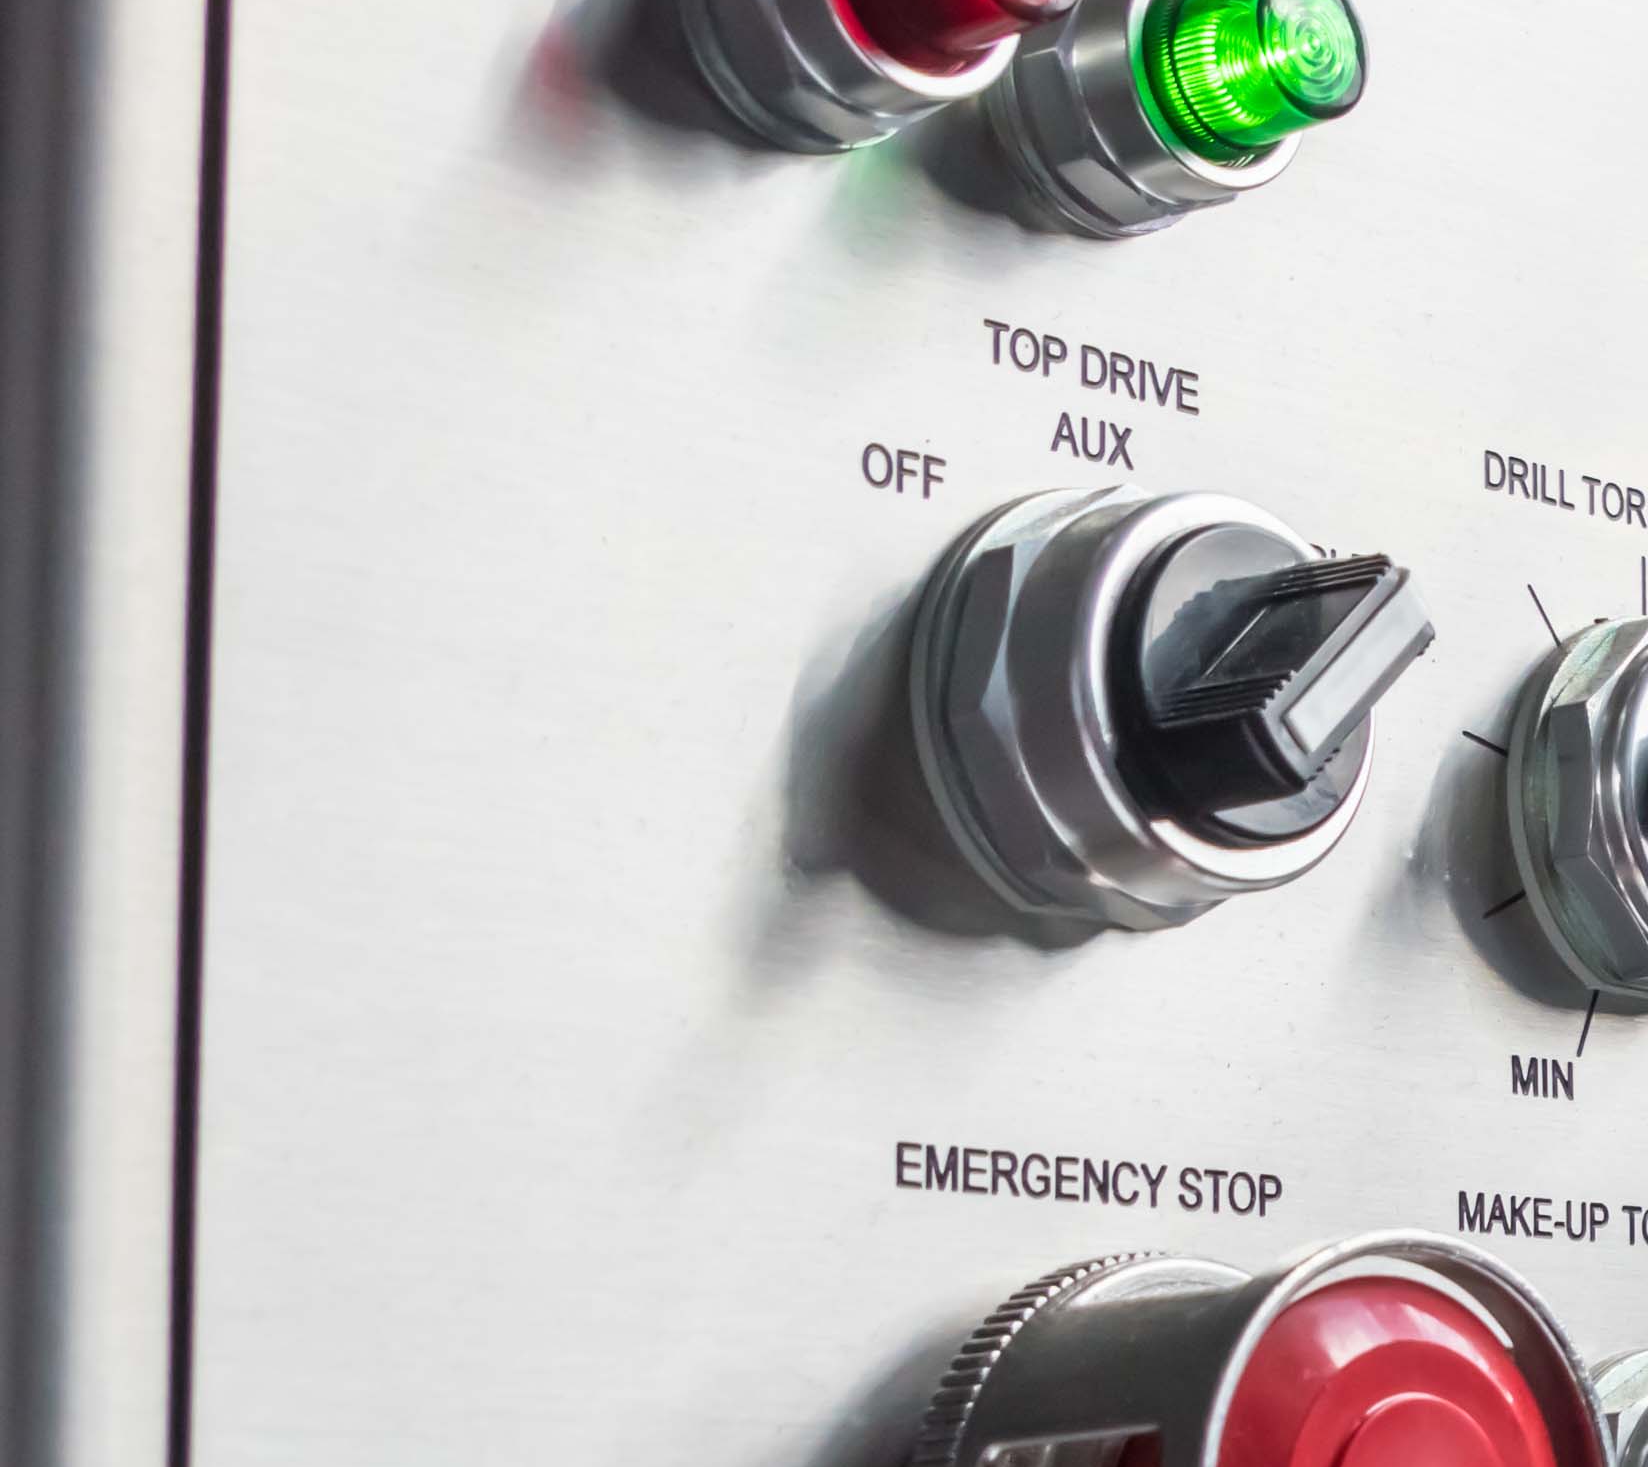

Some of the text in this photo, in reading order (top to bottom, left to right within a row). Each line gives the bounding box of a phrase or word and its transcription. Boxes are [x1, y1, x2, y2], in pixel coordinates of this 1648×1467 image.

[983, 318, 1200, 416] TOP DRIVE
[861, 442, 947, 500] OFF
[1050, 411, 1135, 471] AUX
[1484, 449, 1576, 511] DRILL
[1511, 1054, 1575, 1101] MIN
[895, 1141, 1283, 1218] EMERGENCY STOP
[1457, 1190, 1609, 1243] MAKE-UP
